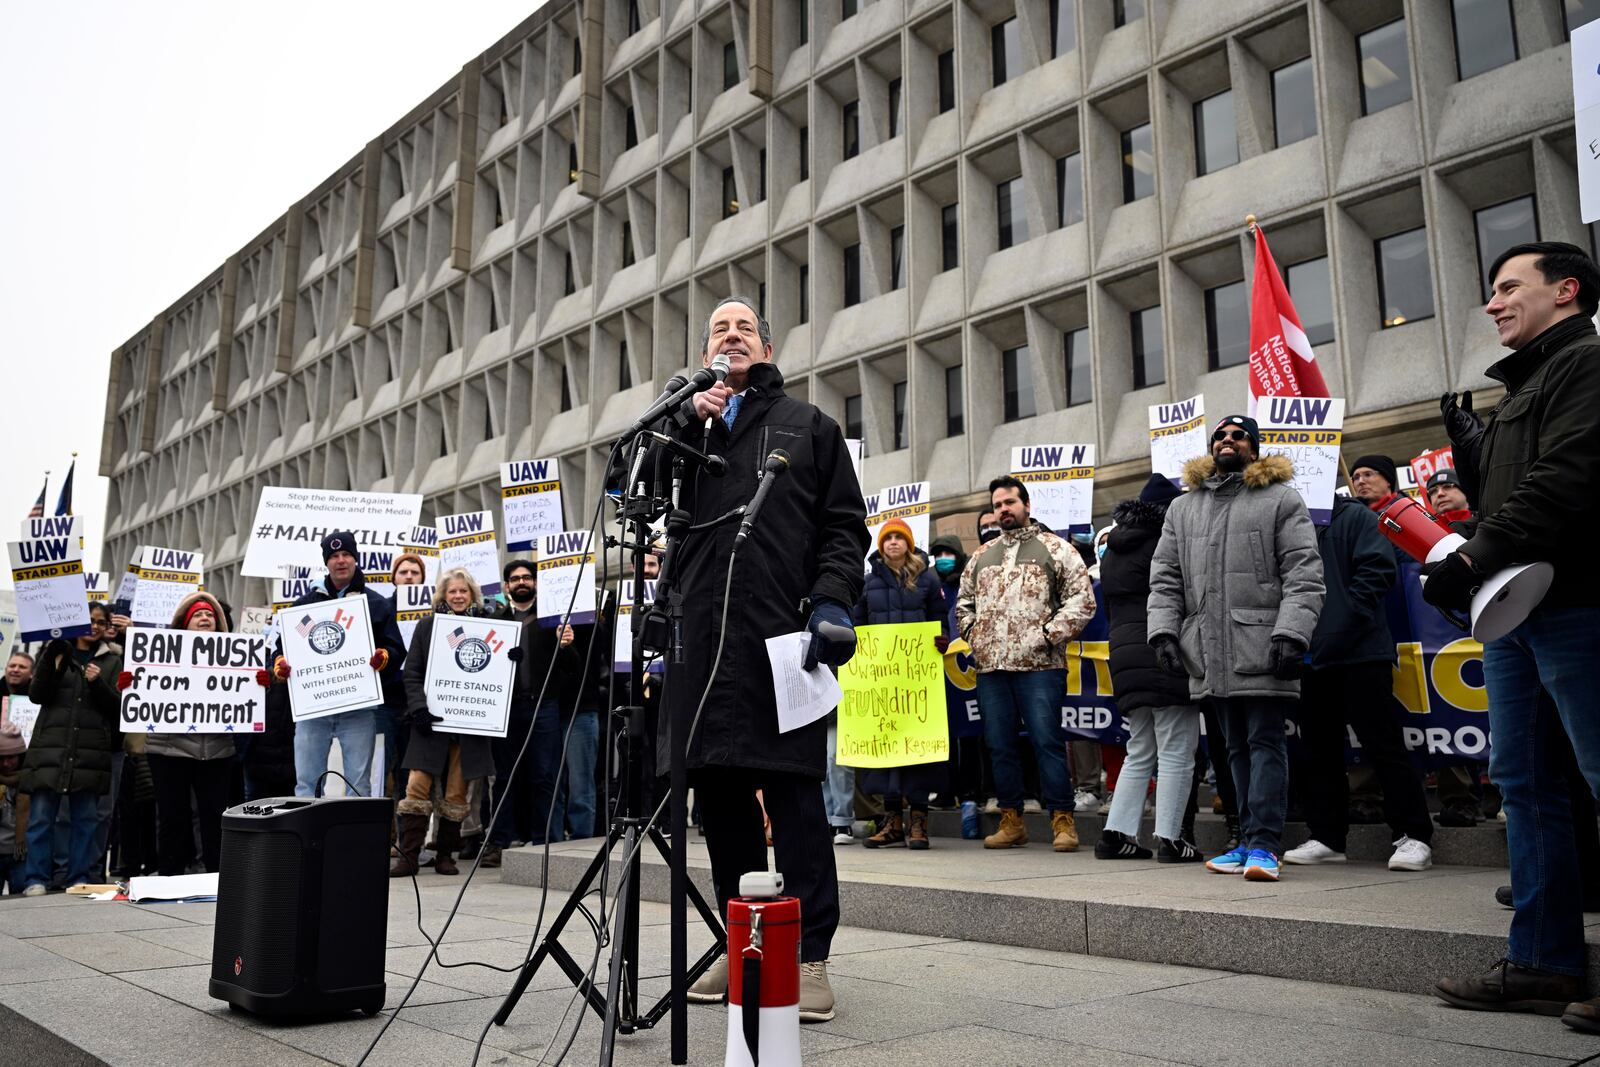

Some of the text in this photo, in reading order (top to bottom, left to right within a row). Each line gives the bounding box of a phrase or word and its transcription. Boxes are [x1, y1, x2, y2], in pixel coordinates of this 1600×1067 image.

[1250, 351, 1276, 397] United
[1260, 342, 1284, 391] Nurses
[1269, 335, 1302, 396] National
[1159, 399, 1196, 423] UAW
[1269, 399, 1331, 426] UAW
[1153, 419, 1202, 438] STAND UP
[1258, 433, 1337, 443] STAND UP
[1021, 447, 1063, 468] UAW
[509, 461, 548, 482] UAW
[1013, 472, 1068, 482] STAND UP
[287, 493, 394, 506] Stop the Revolt Against
[505, 483, 557, 498] STAND UP
[888, 484, 922, 506] UAW
[305, 503, 346, 512] Medicine
[367, 506, 383, 514] the
[385, 507, 412, 515] Media
[509, 511, 546, 525] CANCER
[882, 505, 927, 519] STAND UP
[31, 517, 74, 538] UAW
[445, 513, 483, 535] UAW
[411, 526, 438, 545] UAW
[441, 534, 492, 550] STAND UP
[546, 532, 584, 555] UAW
[18, 538, 68, 563] UAW
[152, 549, 194, 570] UAW
[404, 548, 428, 556] STAND
[358, 552, 392, 570] UAW
[540, 556, 592, 570] STAND UP
[16, 563, 79, 580] STAND UP
[142, 571, 179, 581] STAND
[401, 612, 430, 621] STAN
[131, 632, 264, 667] BAN MUSK
[296, 656, 366, 678] IFPTE STANDS
[858, 659, 937, 681] wanna have
[133, 667, 250, 692] from our
[302, 672, 365, 690] WITH FEDERAL
[435, 679, 503, 693] IFPTE STANDS
[313, 685, 357, 700] WORKERS
[437, 694, 497, 706] WITH FEDERAL
[121, 693, 257, 723] Government
[444, 707, 487, 718] WORKERS
[841, 734, 898, 758] Scientific
